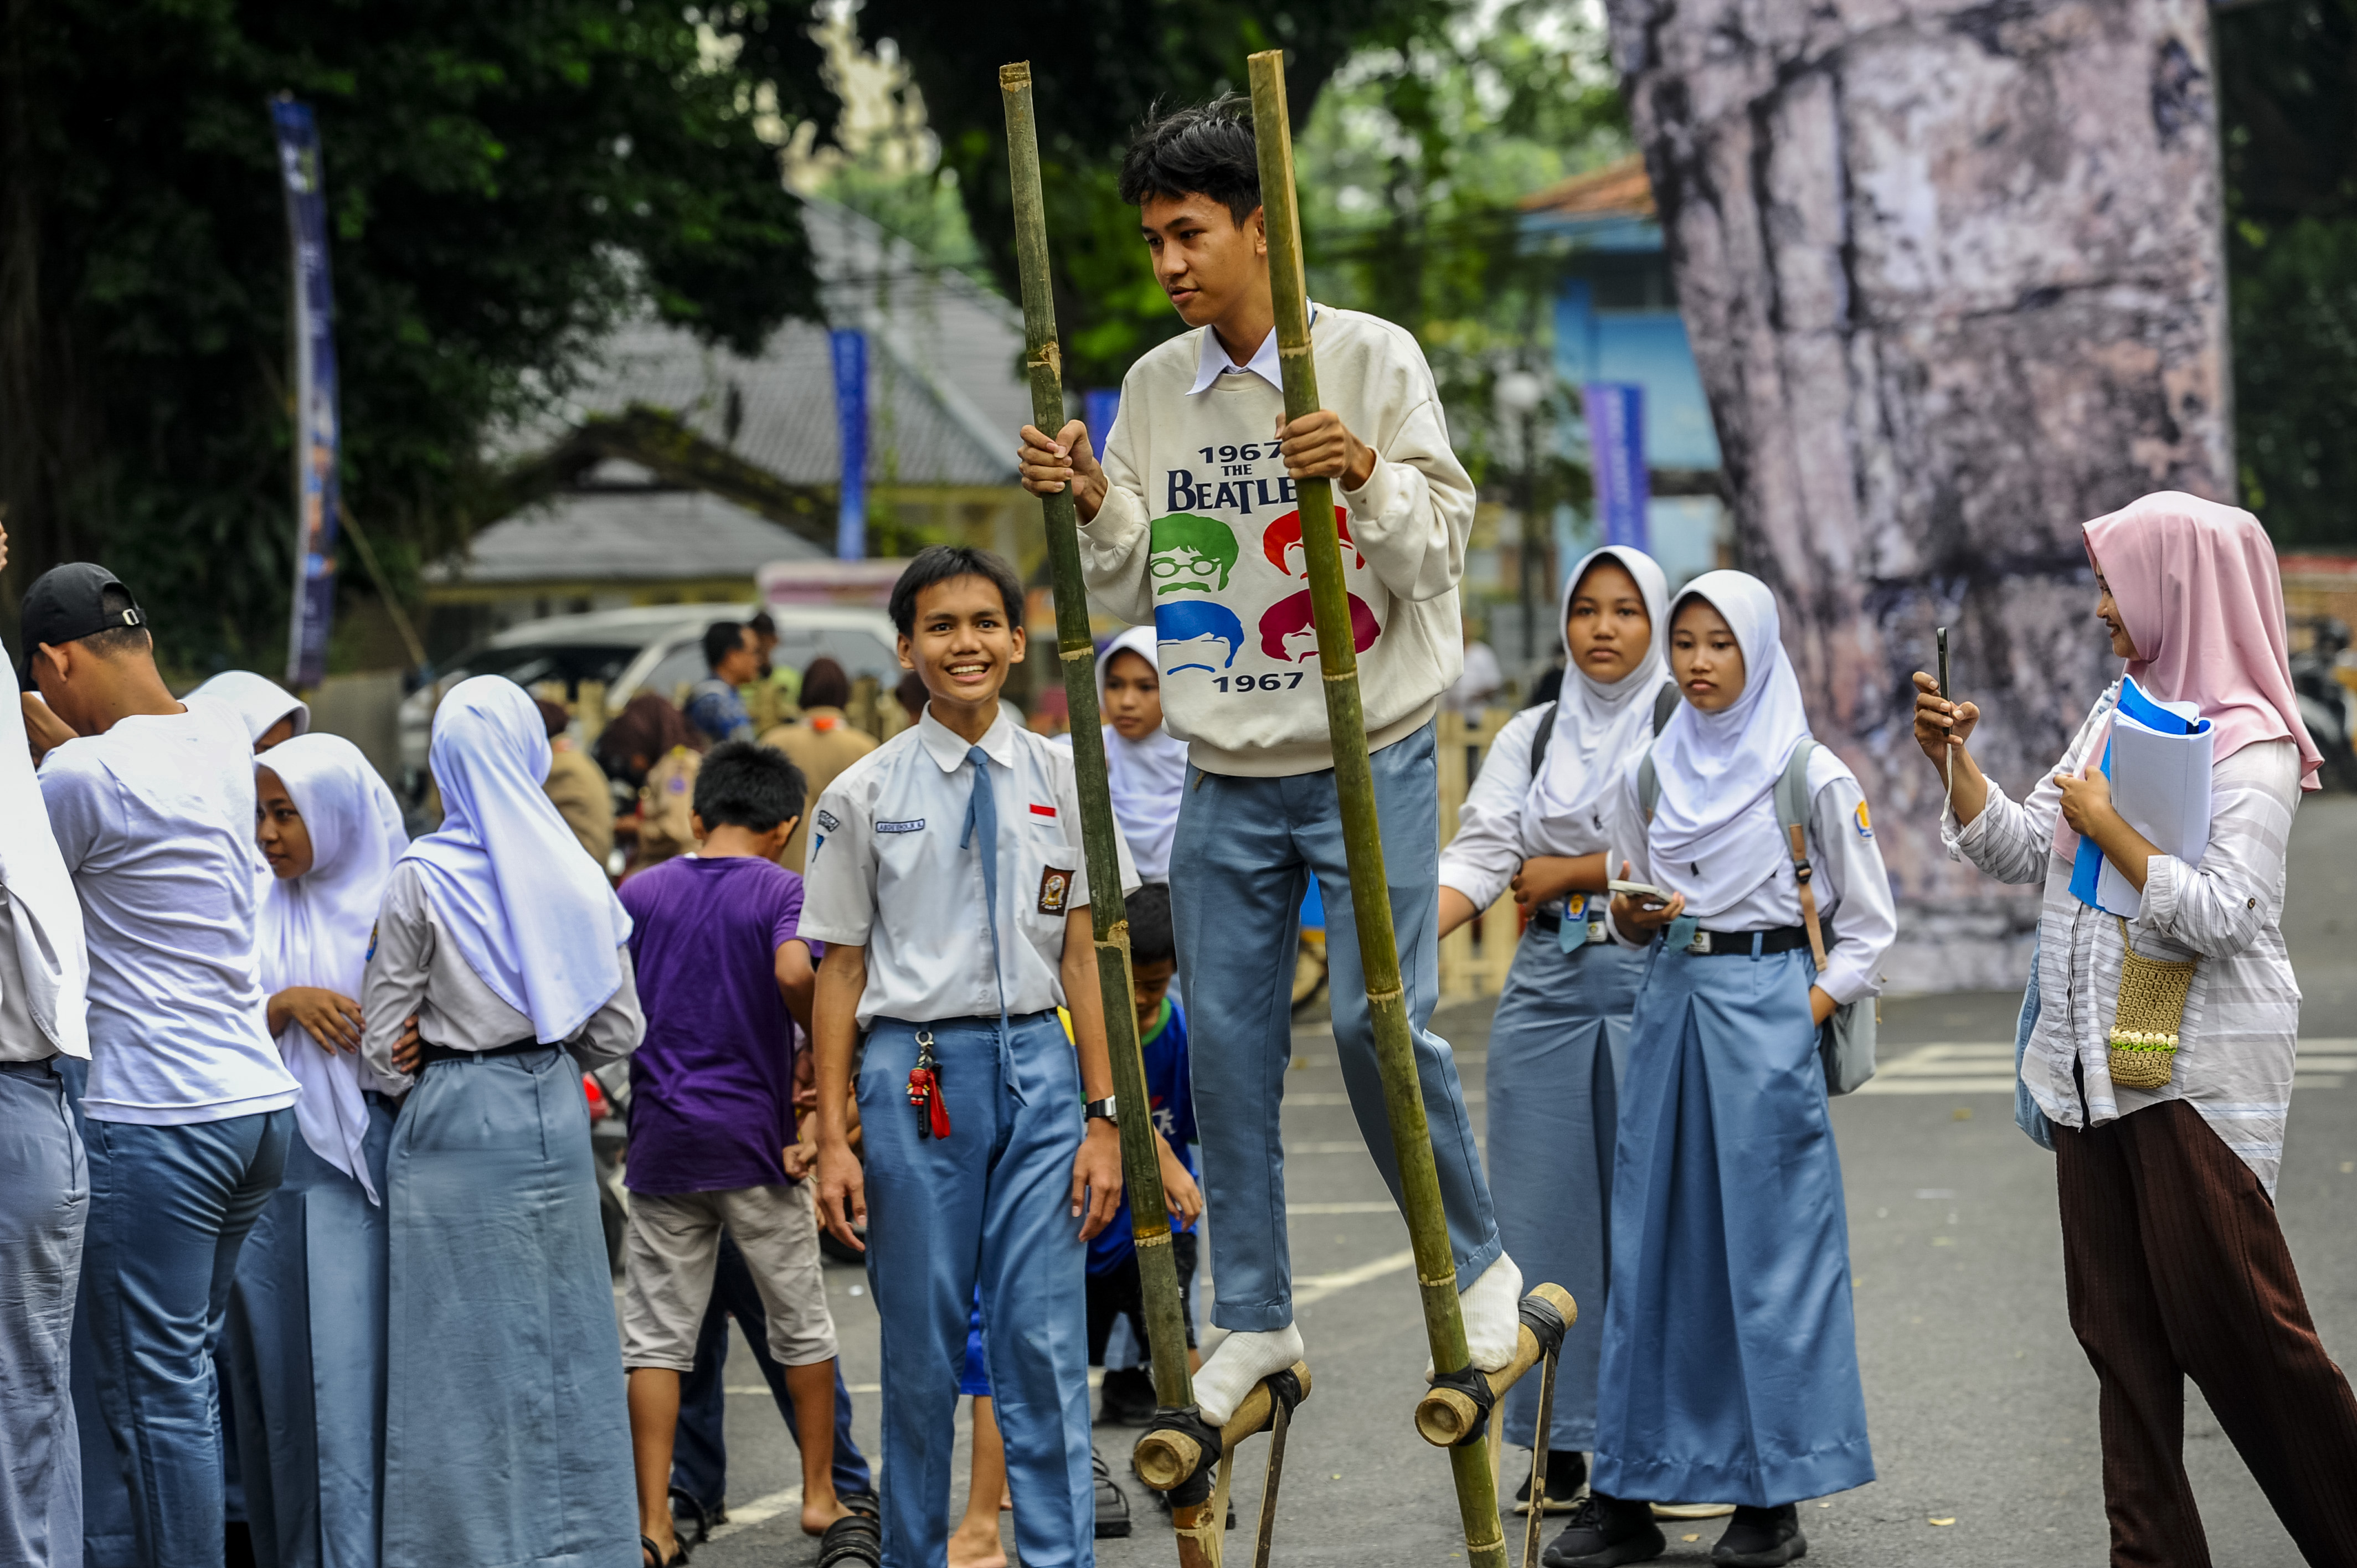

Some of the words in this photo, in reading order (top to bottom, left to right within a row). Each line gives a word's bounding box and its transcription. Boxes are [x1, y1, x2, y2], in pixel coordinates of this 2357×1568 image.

[1198, 441, 1283, 463] 1967
[1221, 464, 1253, 476] THE
[1166, 470, 1297, 514] BEATLE
[1212, 672, 1304, 693] 1967
